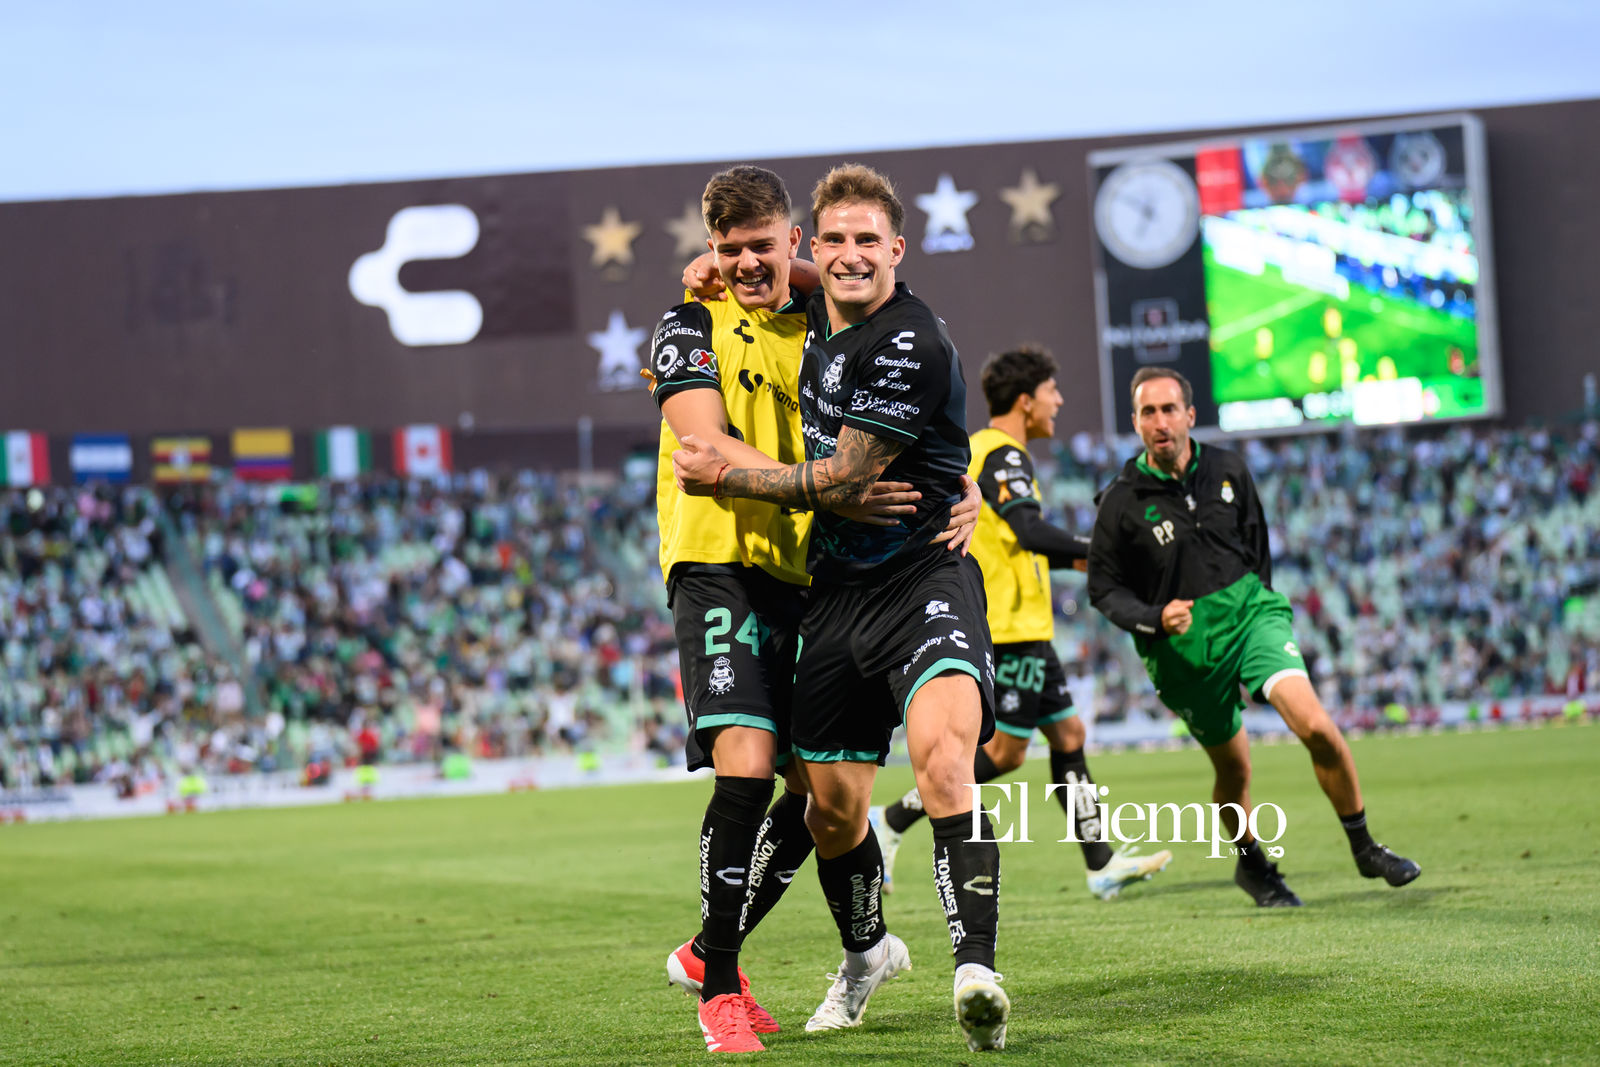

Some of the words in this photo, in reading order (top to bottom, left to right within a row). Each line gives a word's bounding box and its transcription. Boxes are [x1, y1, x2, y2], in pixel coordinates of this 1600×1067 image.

[656, 327, 704, 348] ALAMEDA
[874, 355, 921, 369] Omnibus
[887, 368, 902, 378] de
[871, 378, 911, 391] Mxico
[705, 607, 770, 656] 24
[997, 653, 1047, 694] 205
